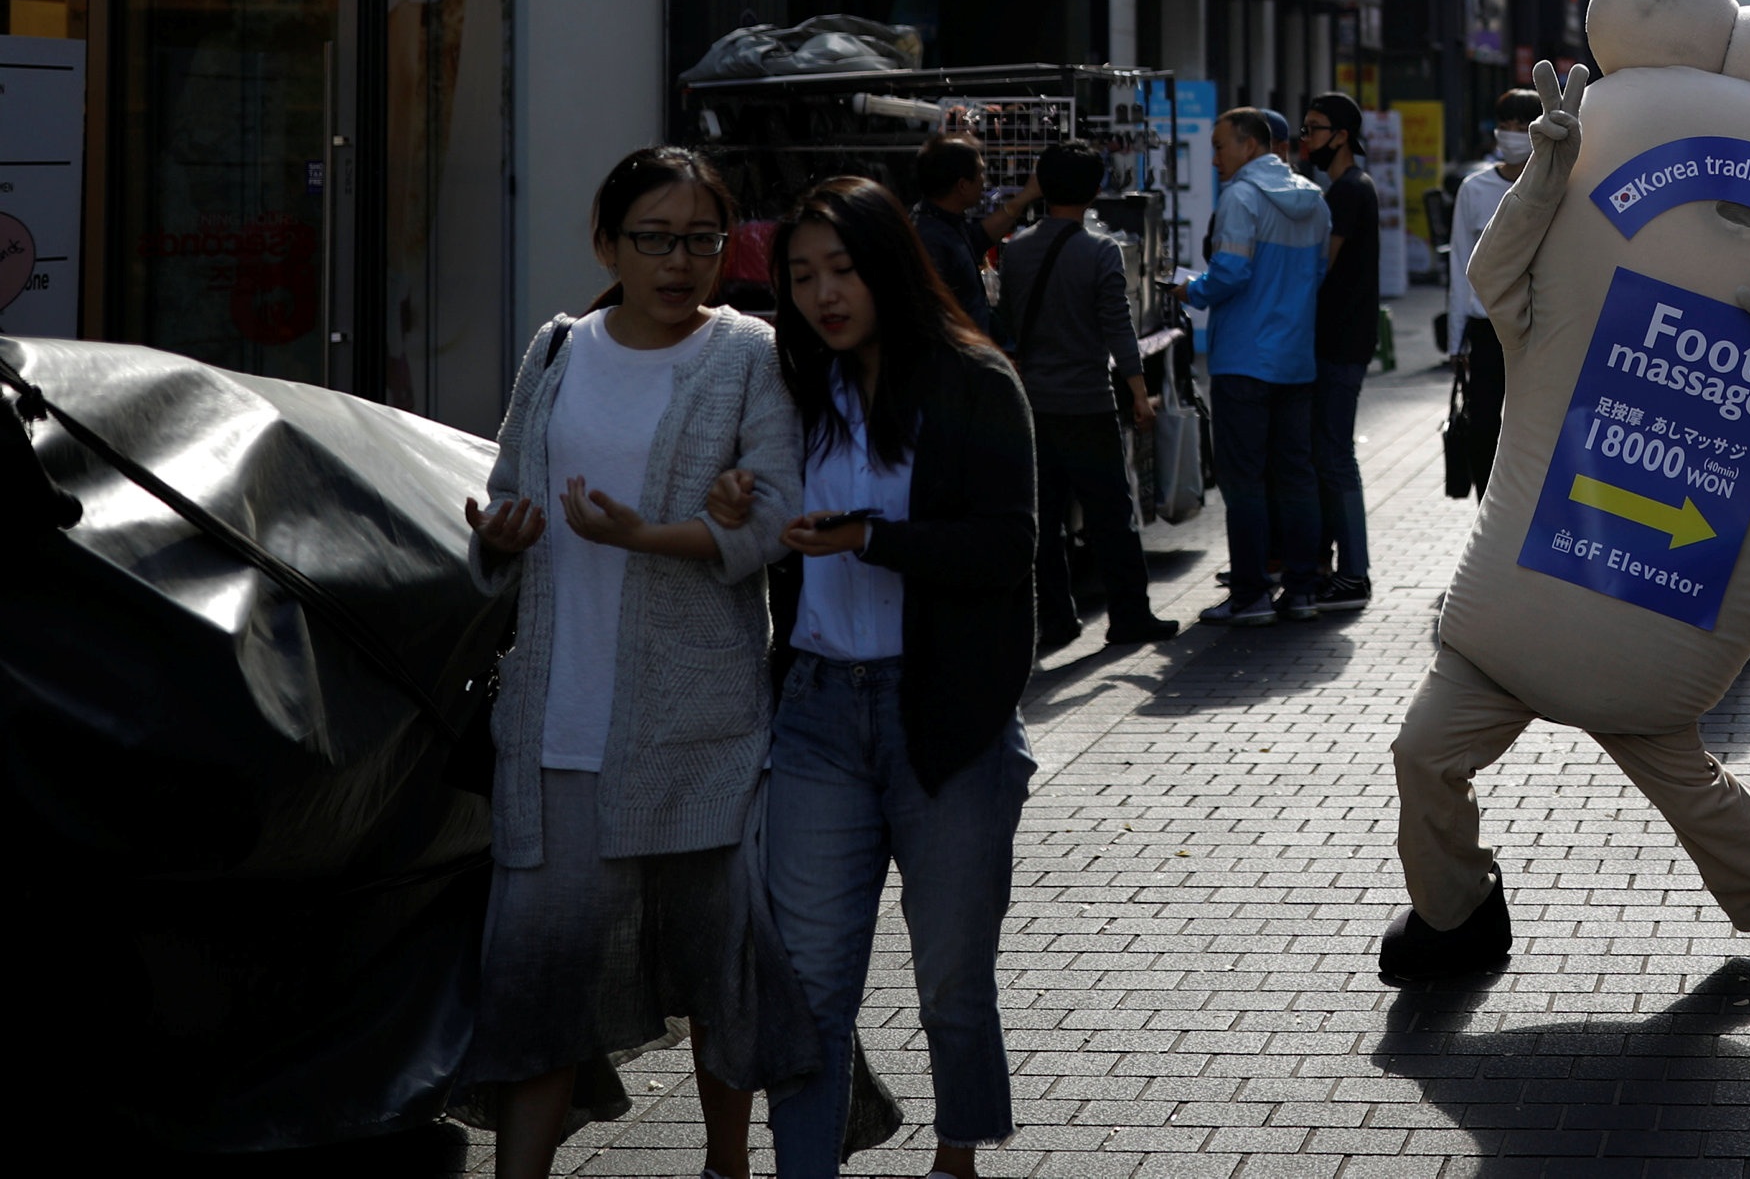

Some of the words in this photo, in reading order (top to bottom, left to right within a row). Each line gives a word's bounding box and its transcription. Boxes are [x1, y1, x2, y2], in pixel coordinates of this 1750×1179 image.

[1634, 154, 1699, 197] Korea
[1585, 419, 1686, 479] 18000
[1686, 467, 1735, 499] WON
[1703, 457, 1740, 480] (40min)
[1574, 539, 1603, 561] 6F
[1606, 548, 1704, 597] Elevator
